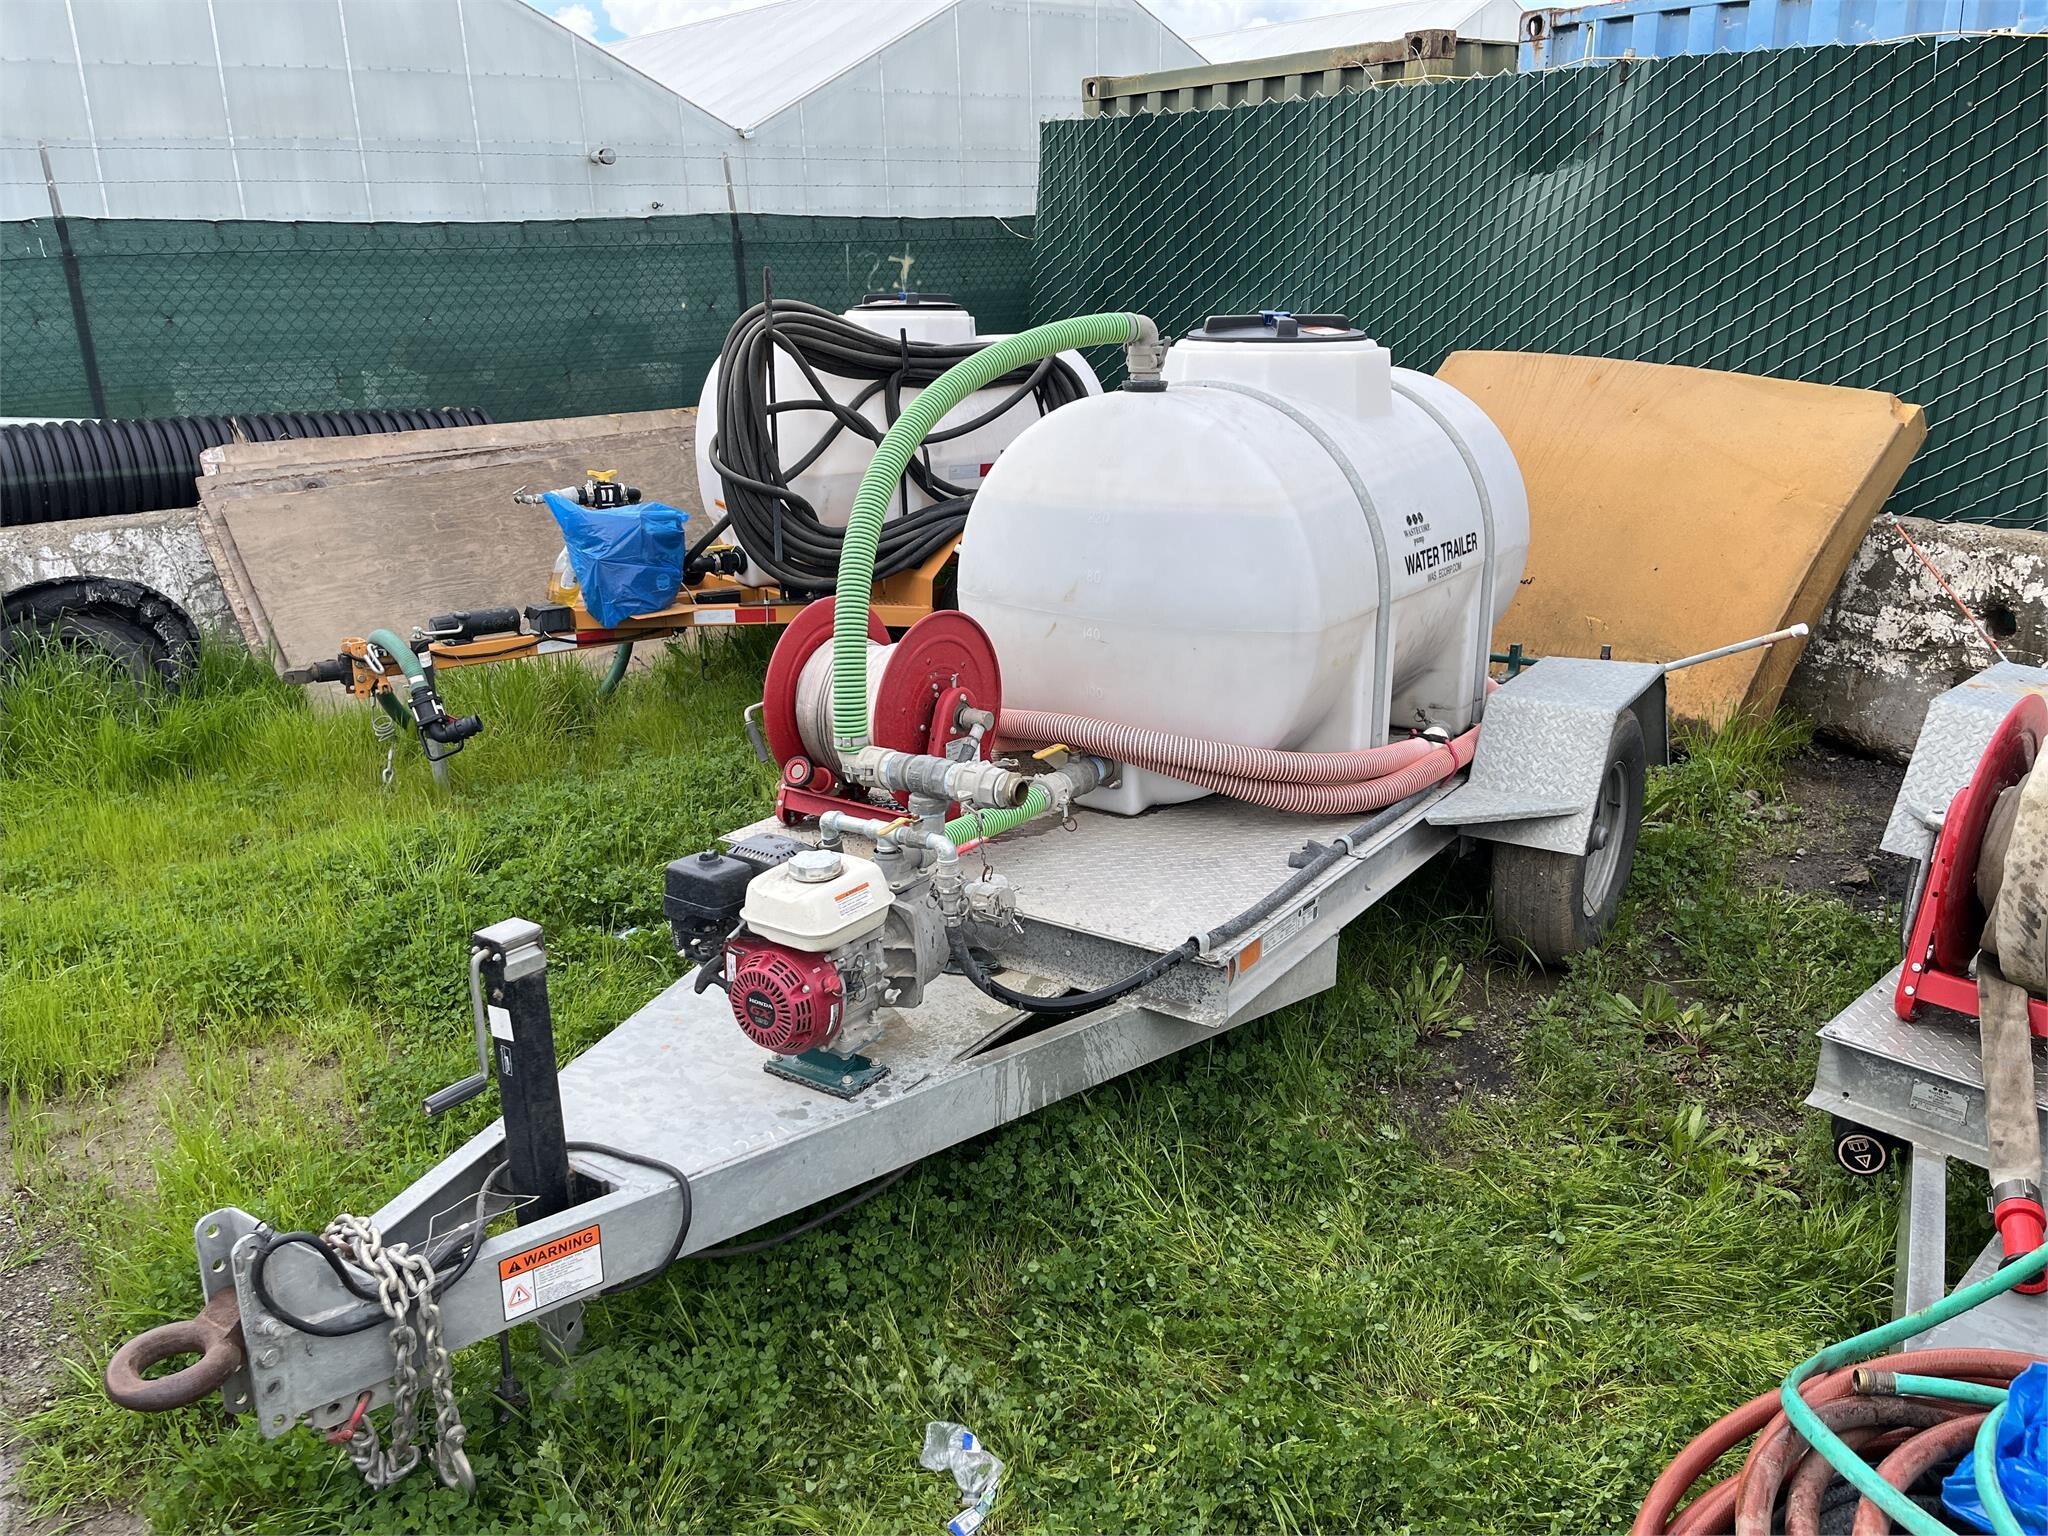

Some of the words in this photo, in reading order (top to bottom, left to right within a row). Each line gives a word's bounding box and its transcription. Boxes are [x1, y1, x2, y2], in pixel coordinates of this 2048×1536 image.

[1404, 546, 1440, 576] WATER
[1441, 532, 1478, 563] TRAILER
[748, 997, 774, 1010] HONDA
[750, 1005, 772, 1020] GX
[523, 1232, 594, 1267] WARNING
